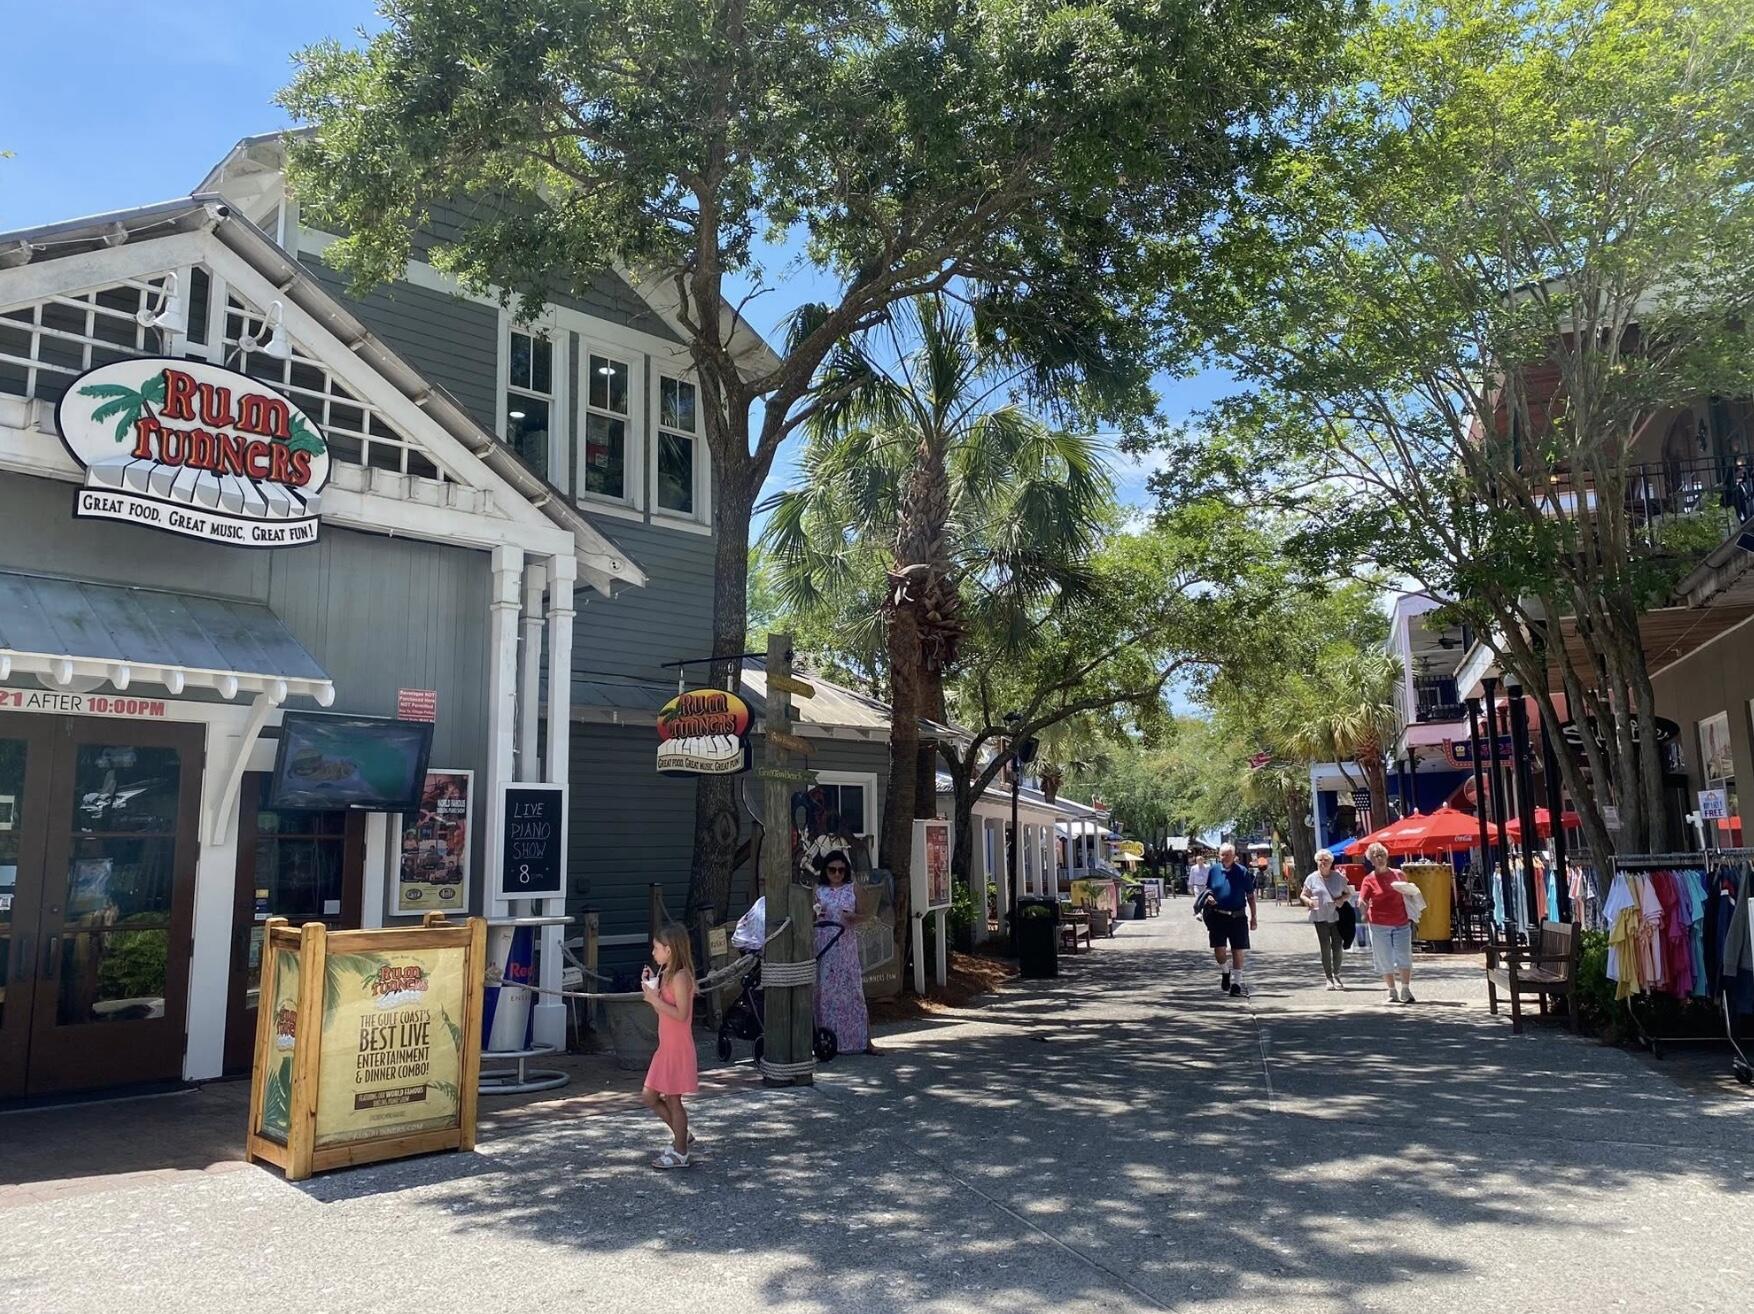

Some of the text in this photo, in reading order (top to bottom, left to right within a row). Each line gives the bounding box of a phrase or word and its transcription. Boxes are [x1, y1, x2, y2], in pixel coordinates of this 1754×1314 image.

[26, 693, 83, 711] AFTER
[87, 697, 165, 717] 10:00PM
[513, 802, 545, 818] LIVE
[1704, 808, 1724, 817] FREE
[511, 822, 551, 839] PIANO
[512, 841, 547, 860] SHOW
[519, 864, 530, 884] 8
[360, 1009, 431, 1028] THE GULF COAST'S
[359, 1022, 431, 1052] BEST LIVE
[357, 1046, 430, 1069] ENTERTAINMENT
[355, 1062, 430, 1084] & DINNER COMBO!
